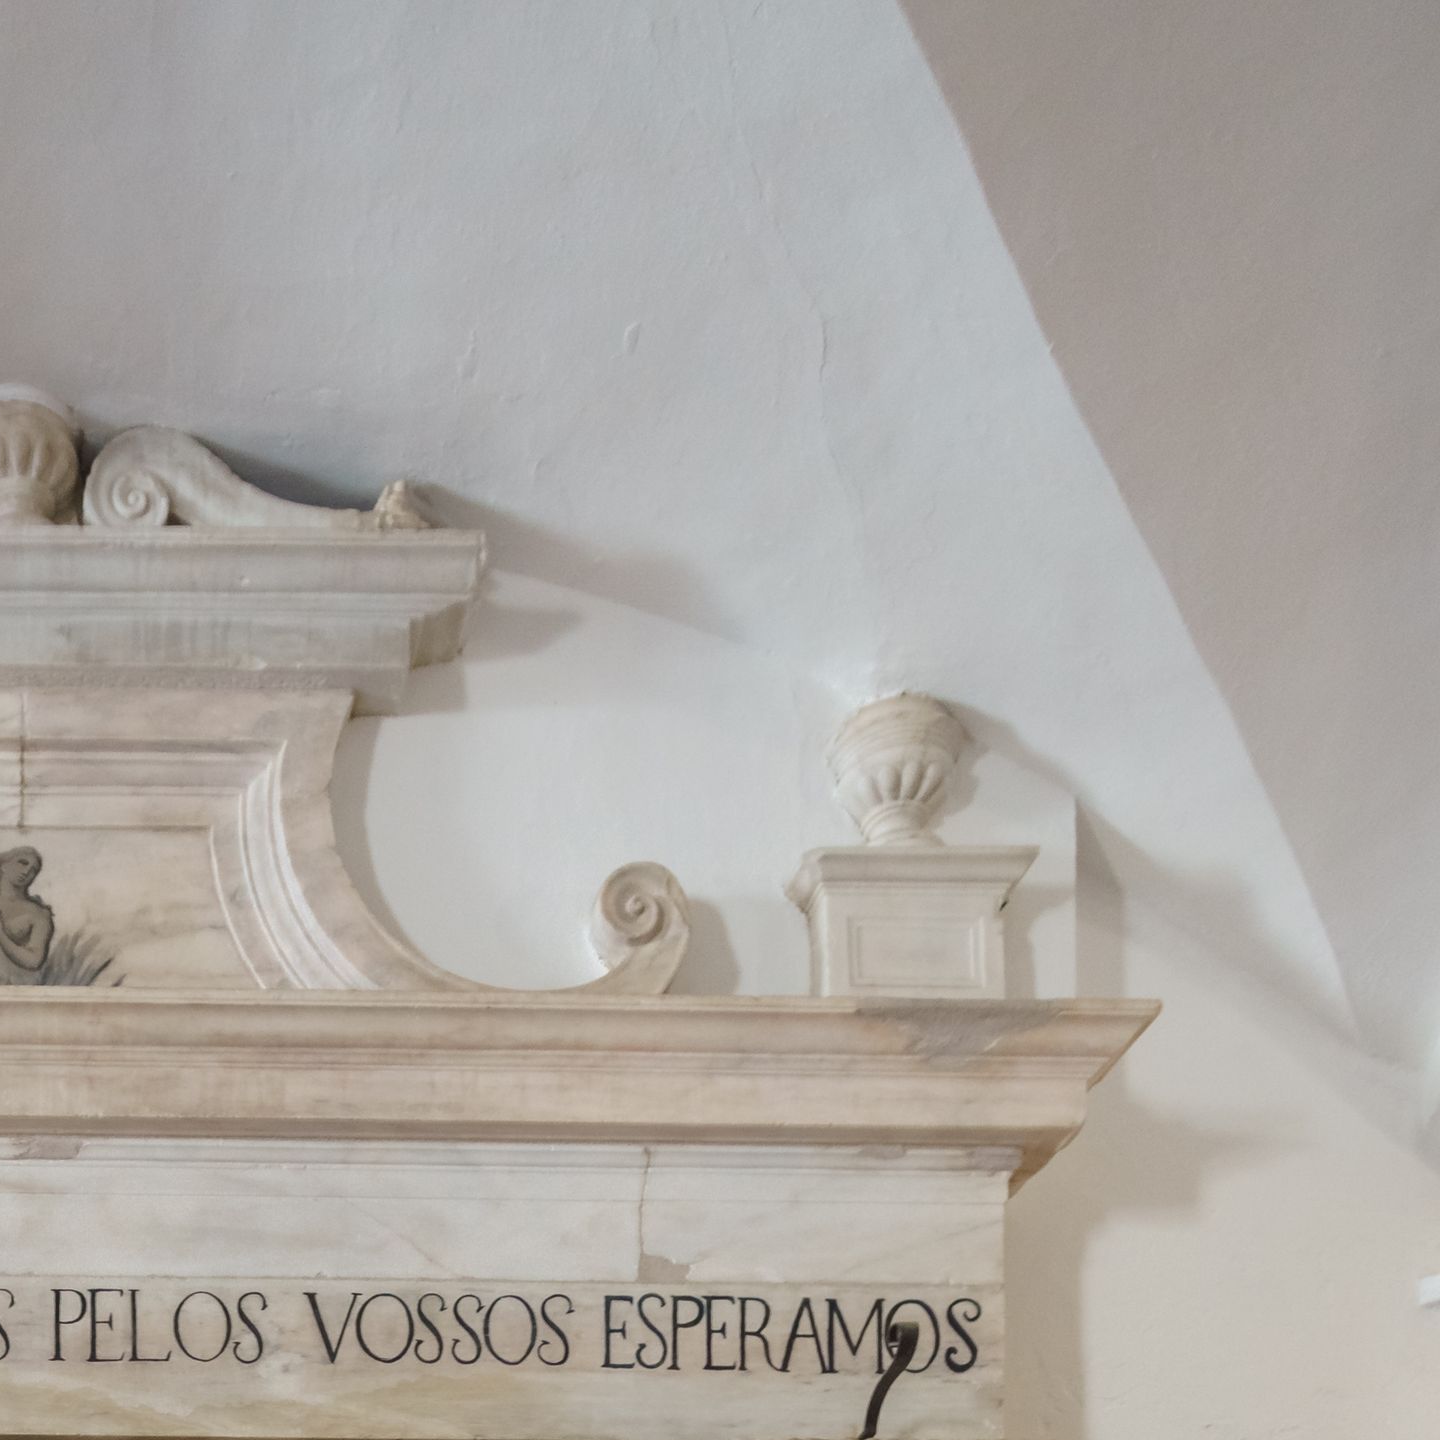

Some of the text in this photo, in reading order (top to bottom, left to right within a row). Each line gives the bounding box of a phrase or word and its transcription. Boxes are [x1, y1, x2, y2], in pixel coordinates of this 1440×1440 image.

[49, 1288, 268, 1365] PELOS
[304, 1292, 574, 1367] VOSSOS
[602, 1293, 981, 1374] ESPERAMOS
